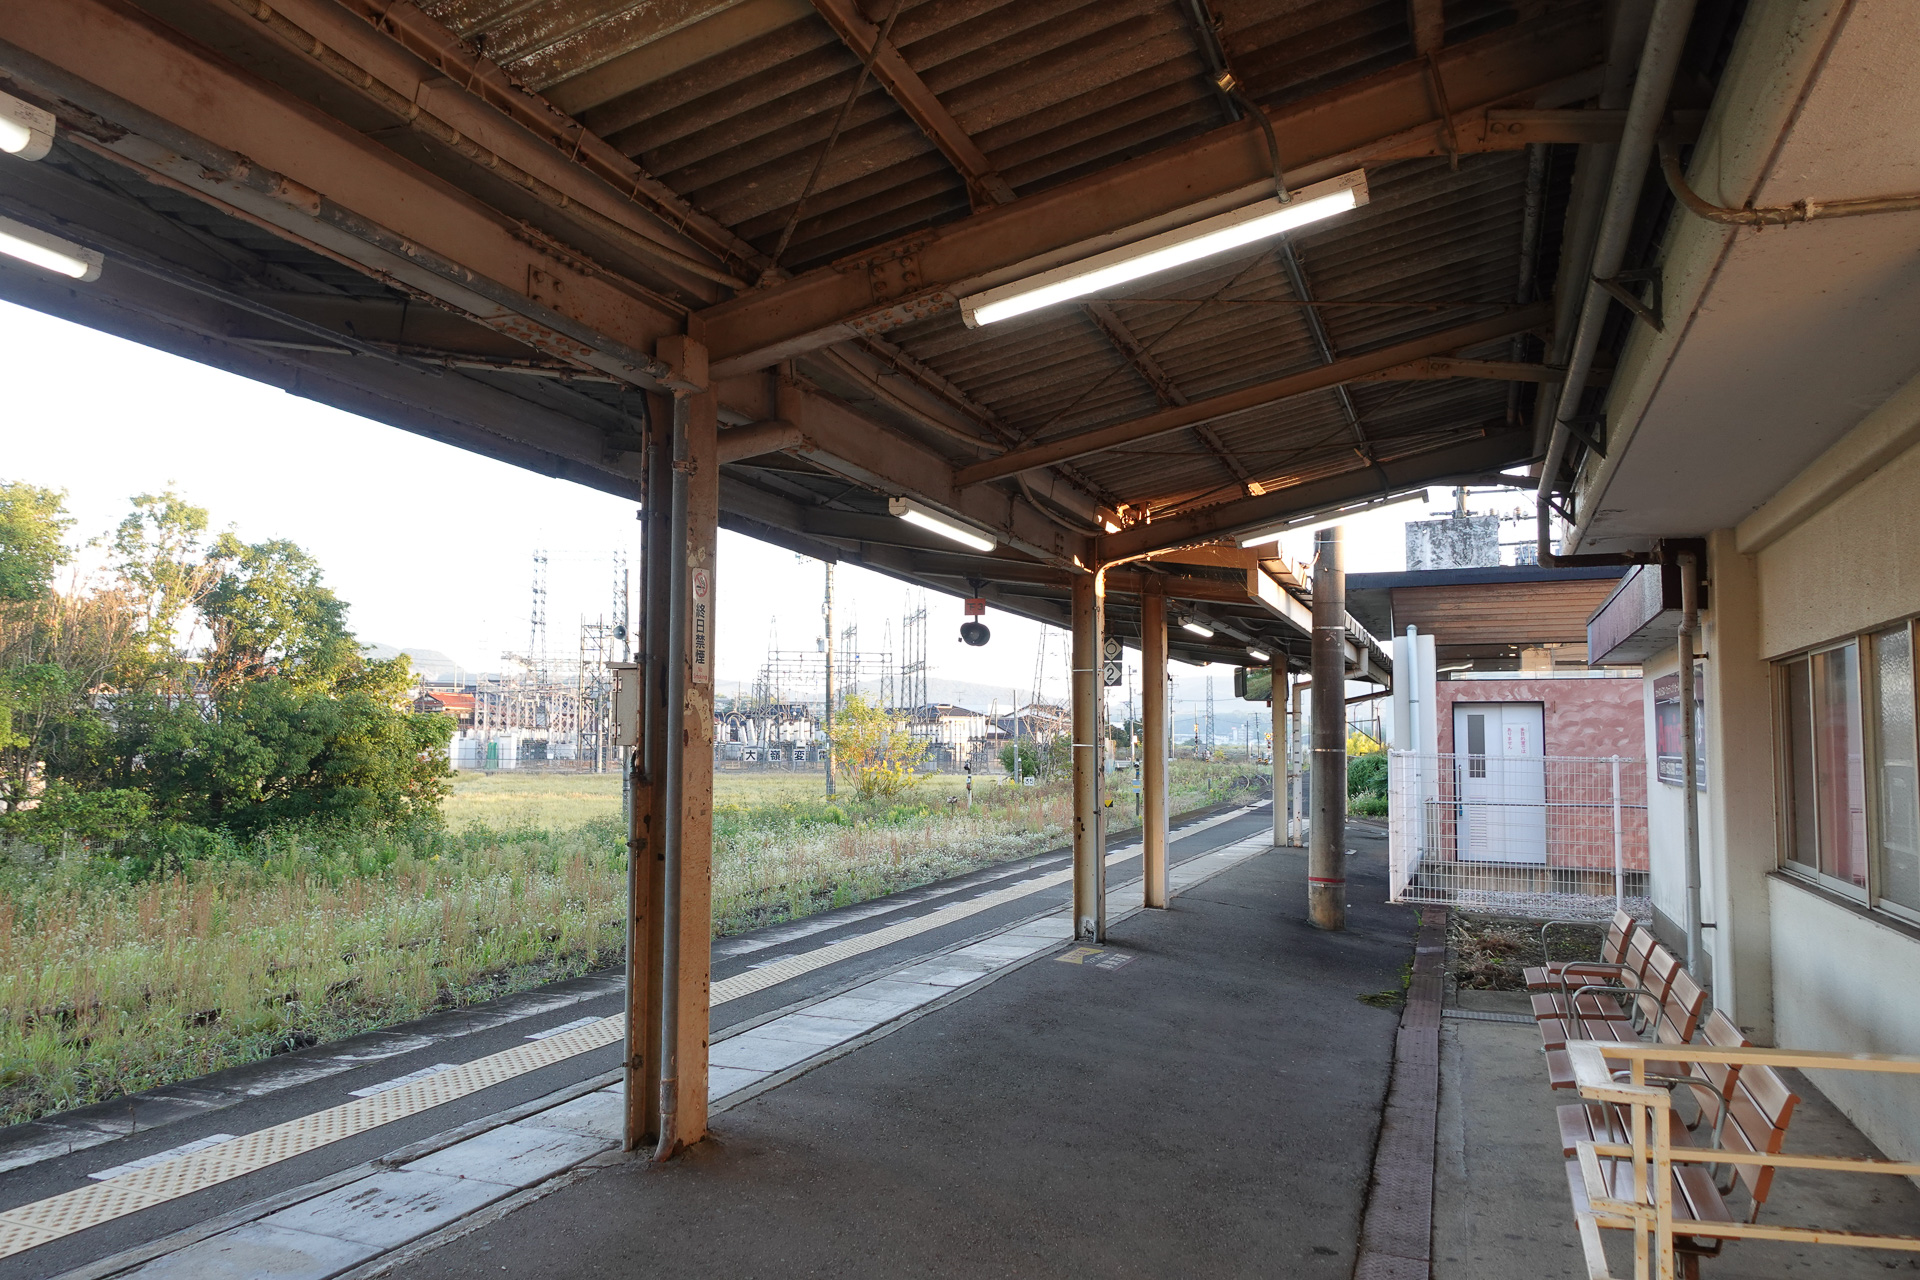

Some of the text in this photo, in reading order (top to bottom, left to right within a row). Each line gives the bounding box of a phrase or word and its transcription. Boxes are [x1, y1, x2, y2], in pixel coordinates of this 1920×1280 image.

[695, 603, 706, 665] 終日禁煙
[1106, 667, 1115, 681] 2
